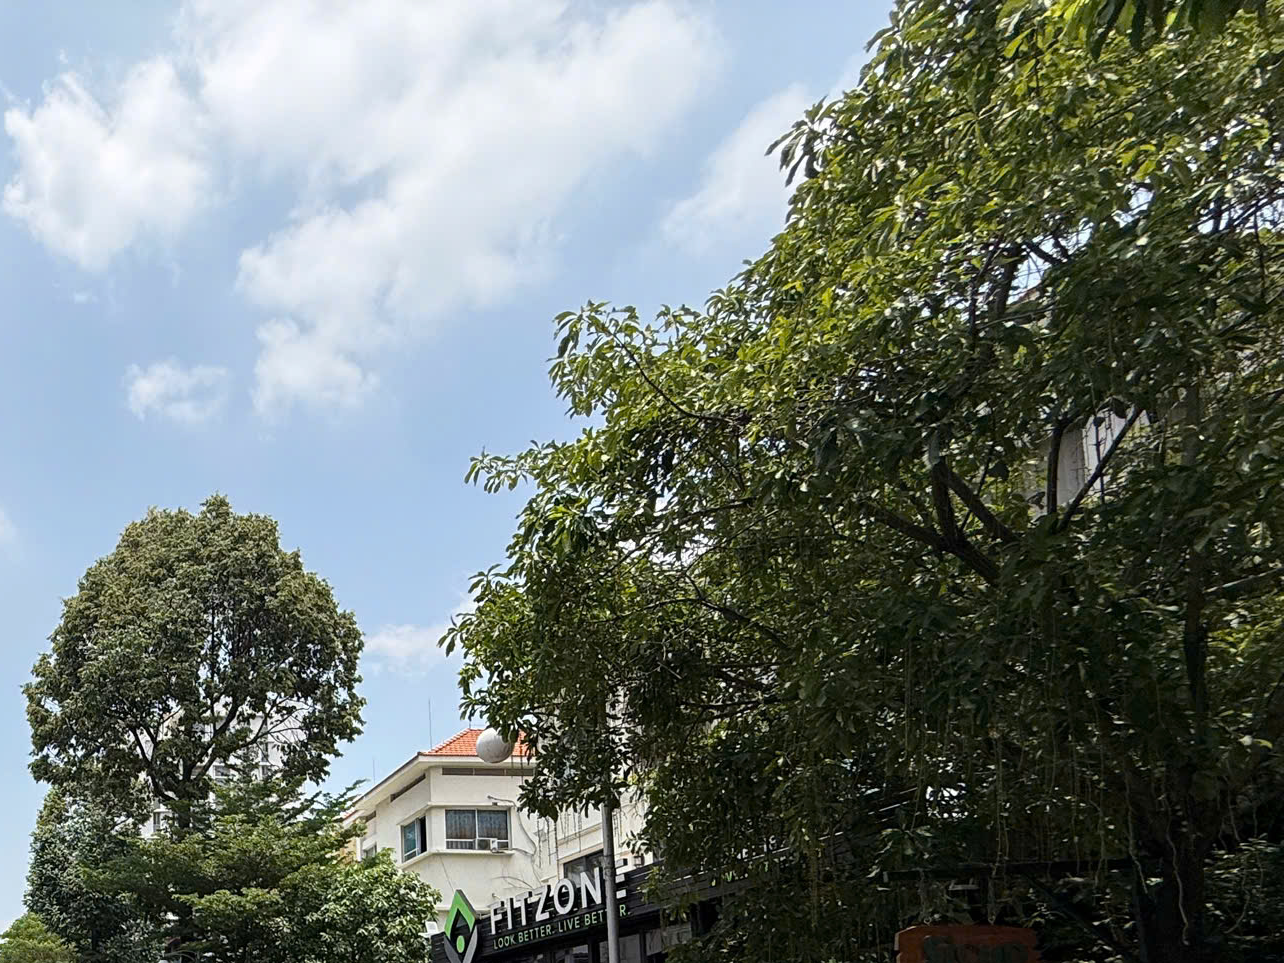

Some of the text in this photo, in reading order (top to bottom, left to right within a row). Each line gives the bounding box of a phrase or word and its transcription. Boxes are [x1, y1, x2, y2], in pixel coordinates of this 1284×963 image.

[493, 934, 516, 950] LOOK
[558, 916, 581, 933] LIVE
[584, 904, 631, 926] BETR.
